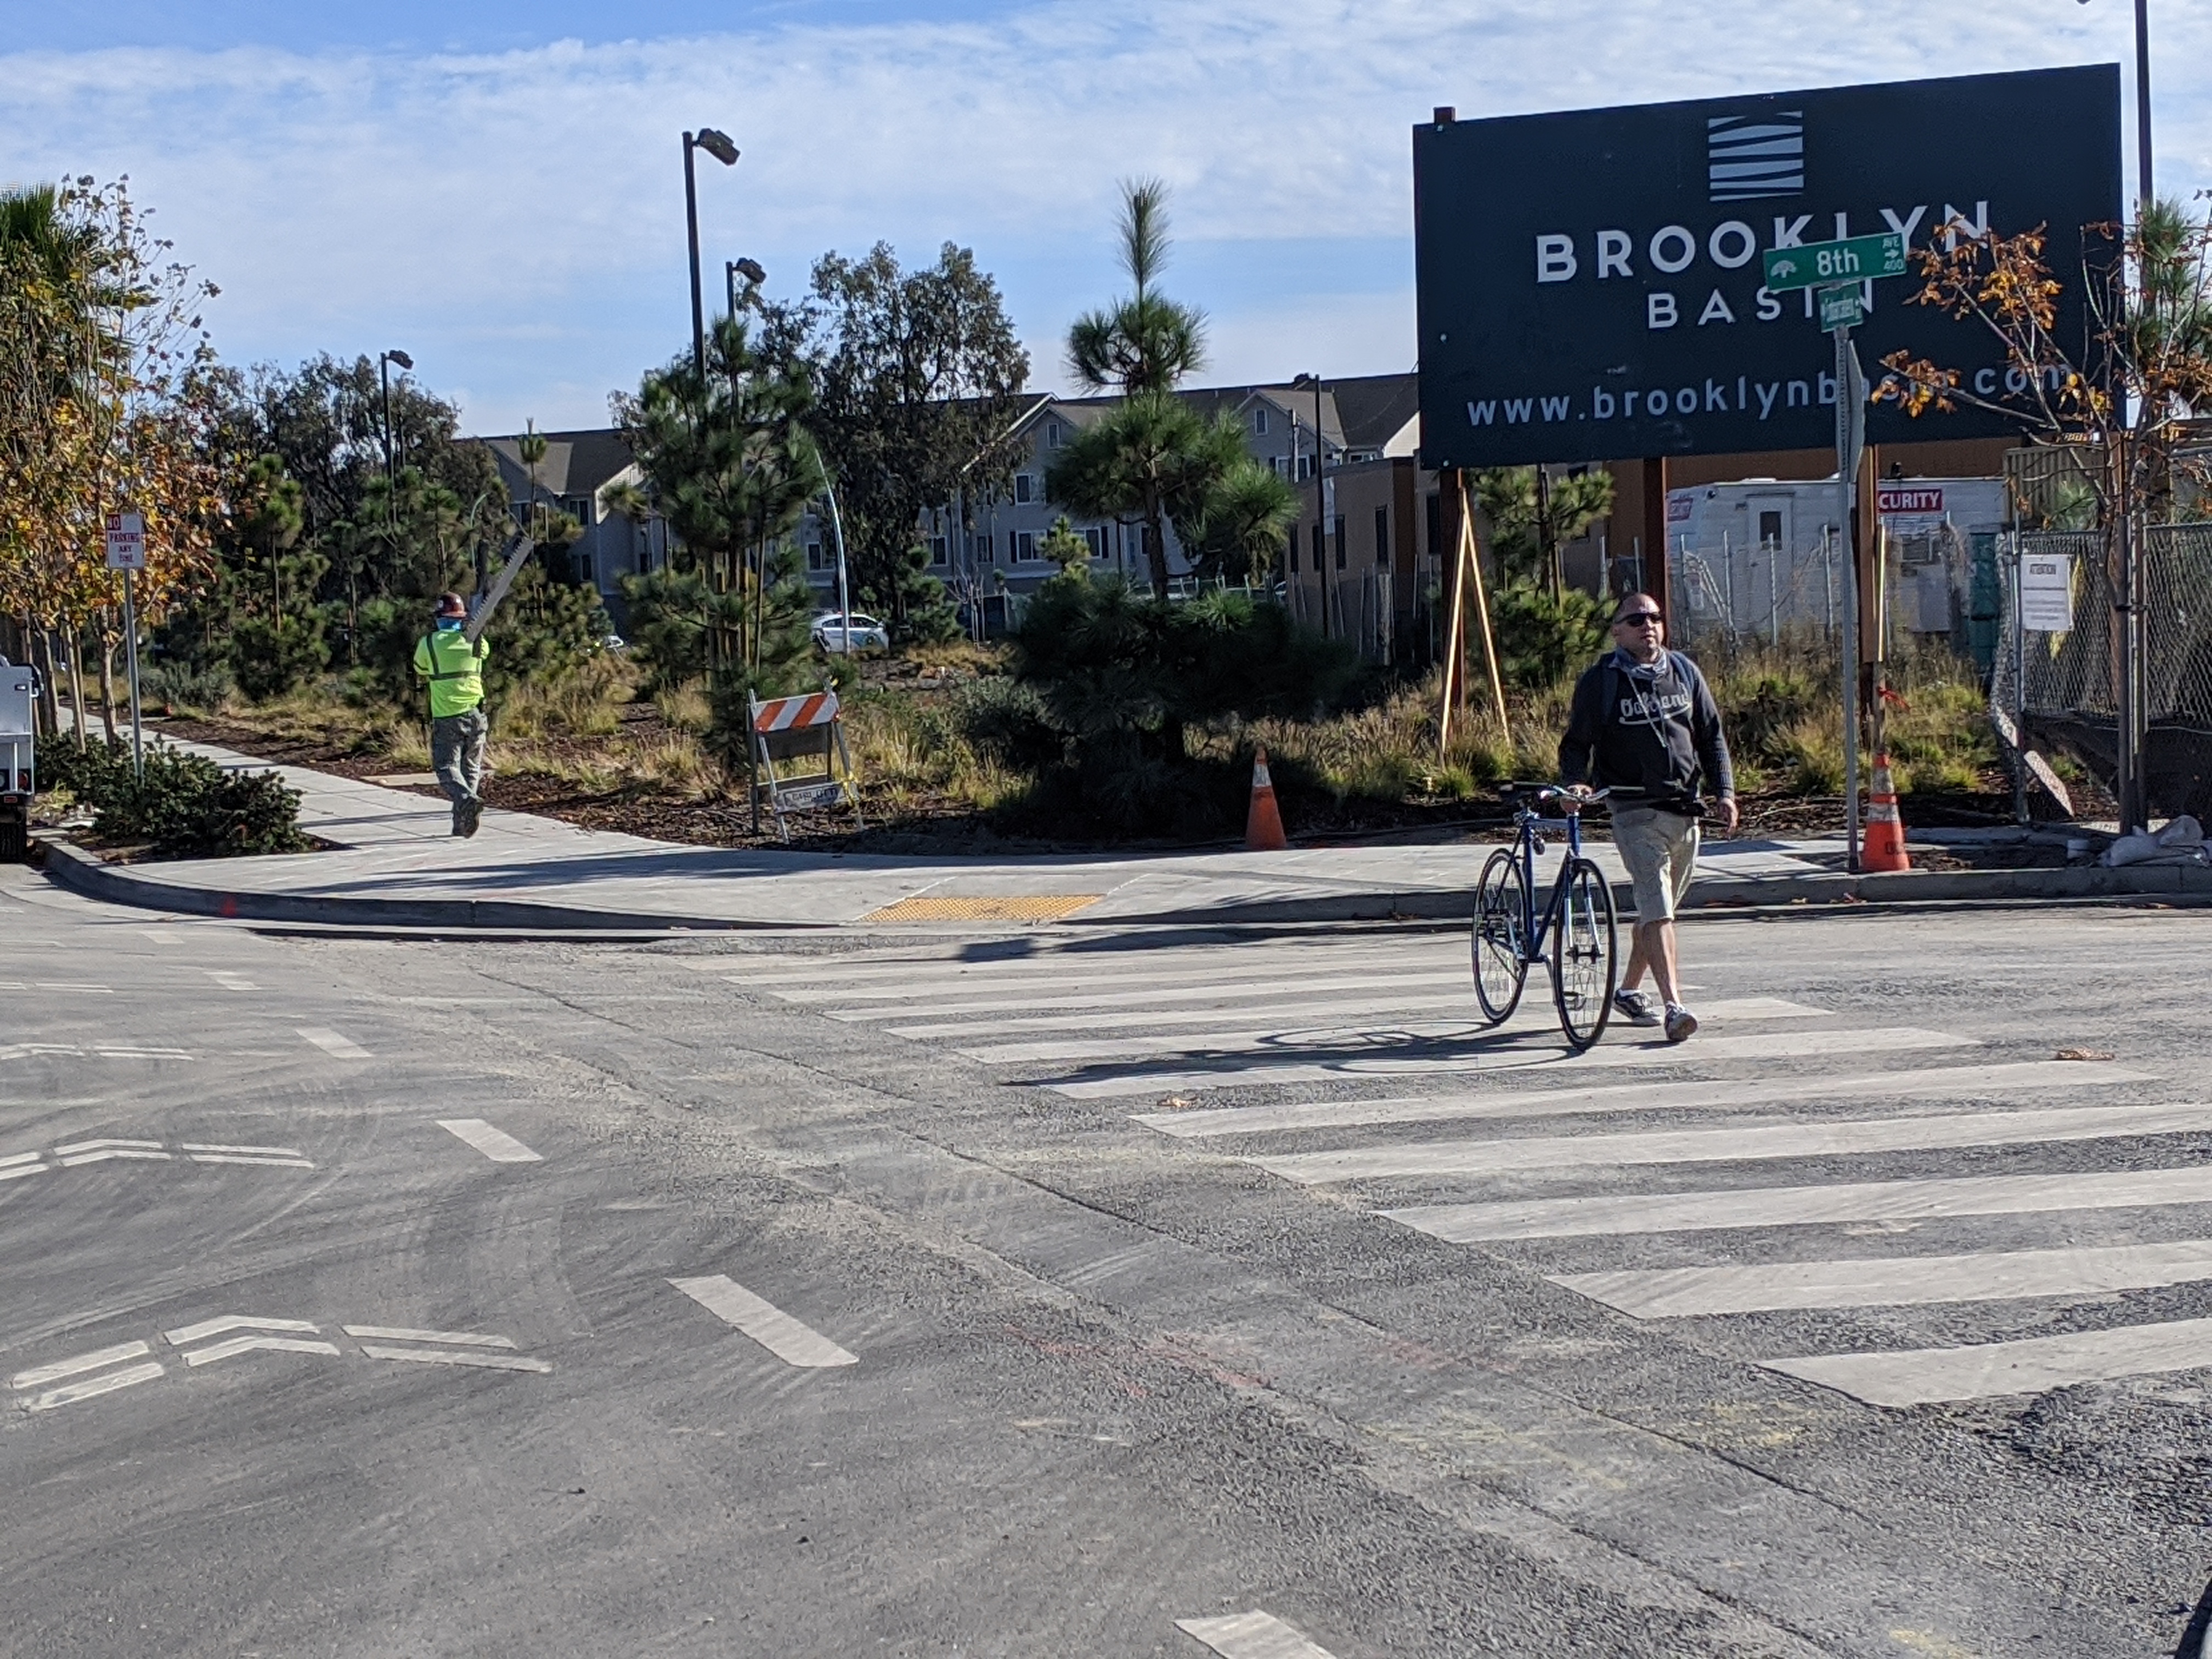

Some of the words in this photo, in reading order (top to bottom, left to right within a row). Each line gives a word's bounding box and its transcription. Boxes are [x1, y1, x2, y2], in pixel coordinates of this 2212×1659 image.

[1882, 235, 1900, 249] AVE
[1816, 247, 1859, 276] 8th
[1883, 259, 1904, 271] 400
[1620, 682, 1691, 717] Oakand
